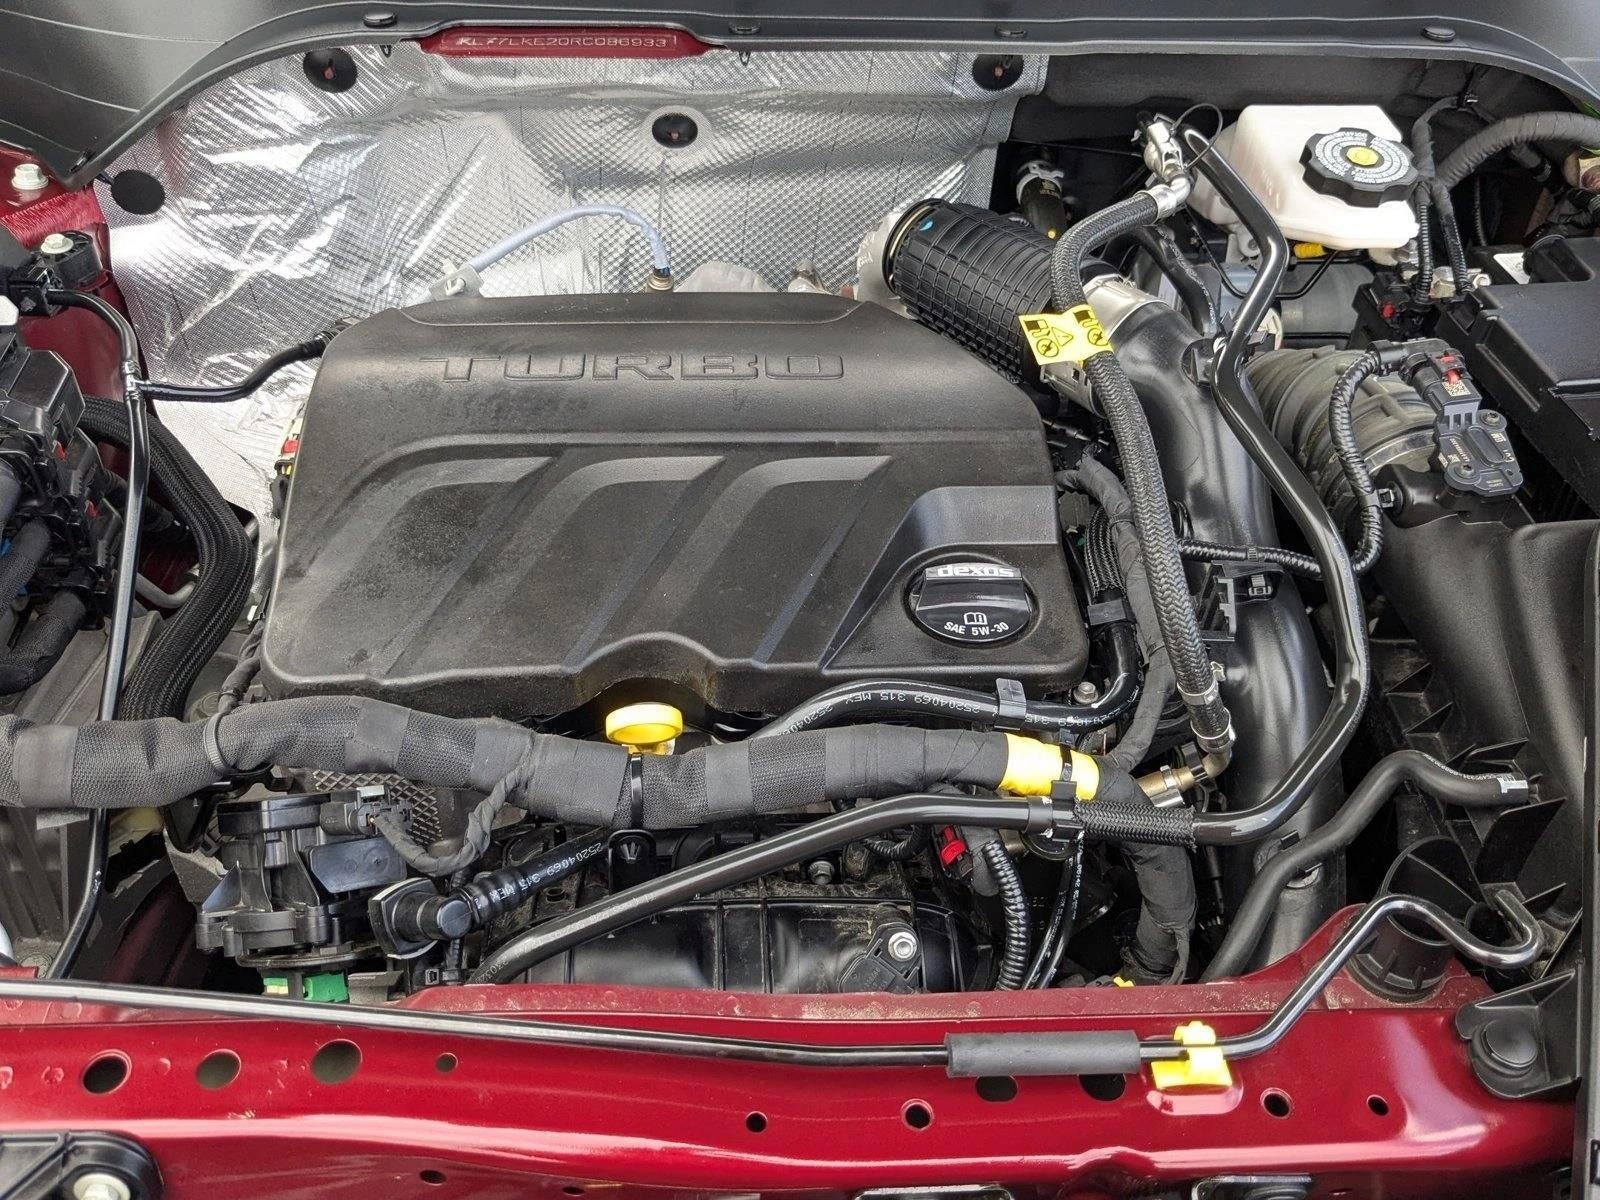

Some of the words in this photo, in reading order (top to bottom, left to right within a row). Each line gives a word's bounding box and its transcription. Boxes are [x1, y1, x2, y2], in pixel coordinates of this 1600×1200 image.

[420, 354, 844, 382] TURBO
[944, 621, 966, 635] SAE
[971, 621, 1010, 636] 5W-30
[879, 692, 907, 702] 315
[914, 694, 981, 714] 25204069
[546, 842, 602, 877] 25204069
